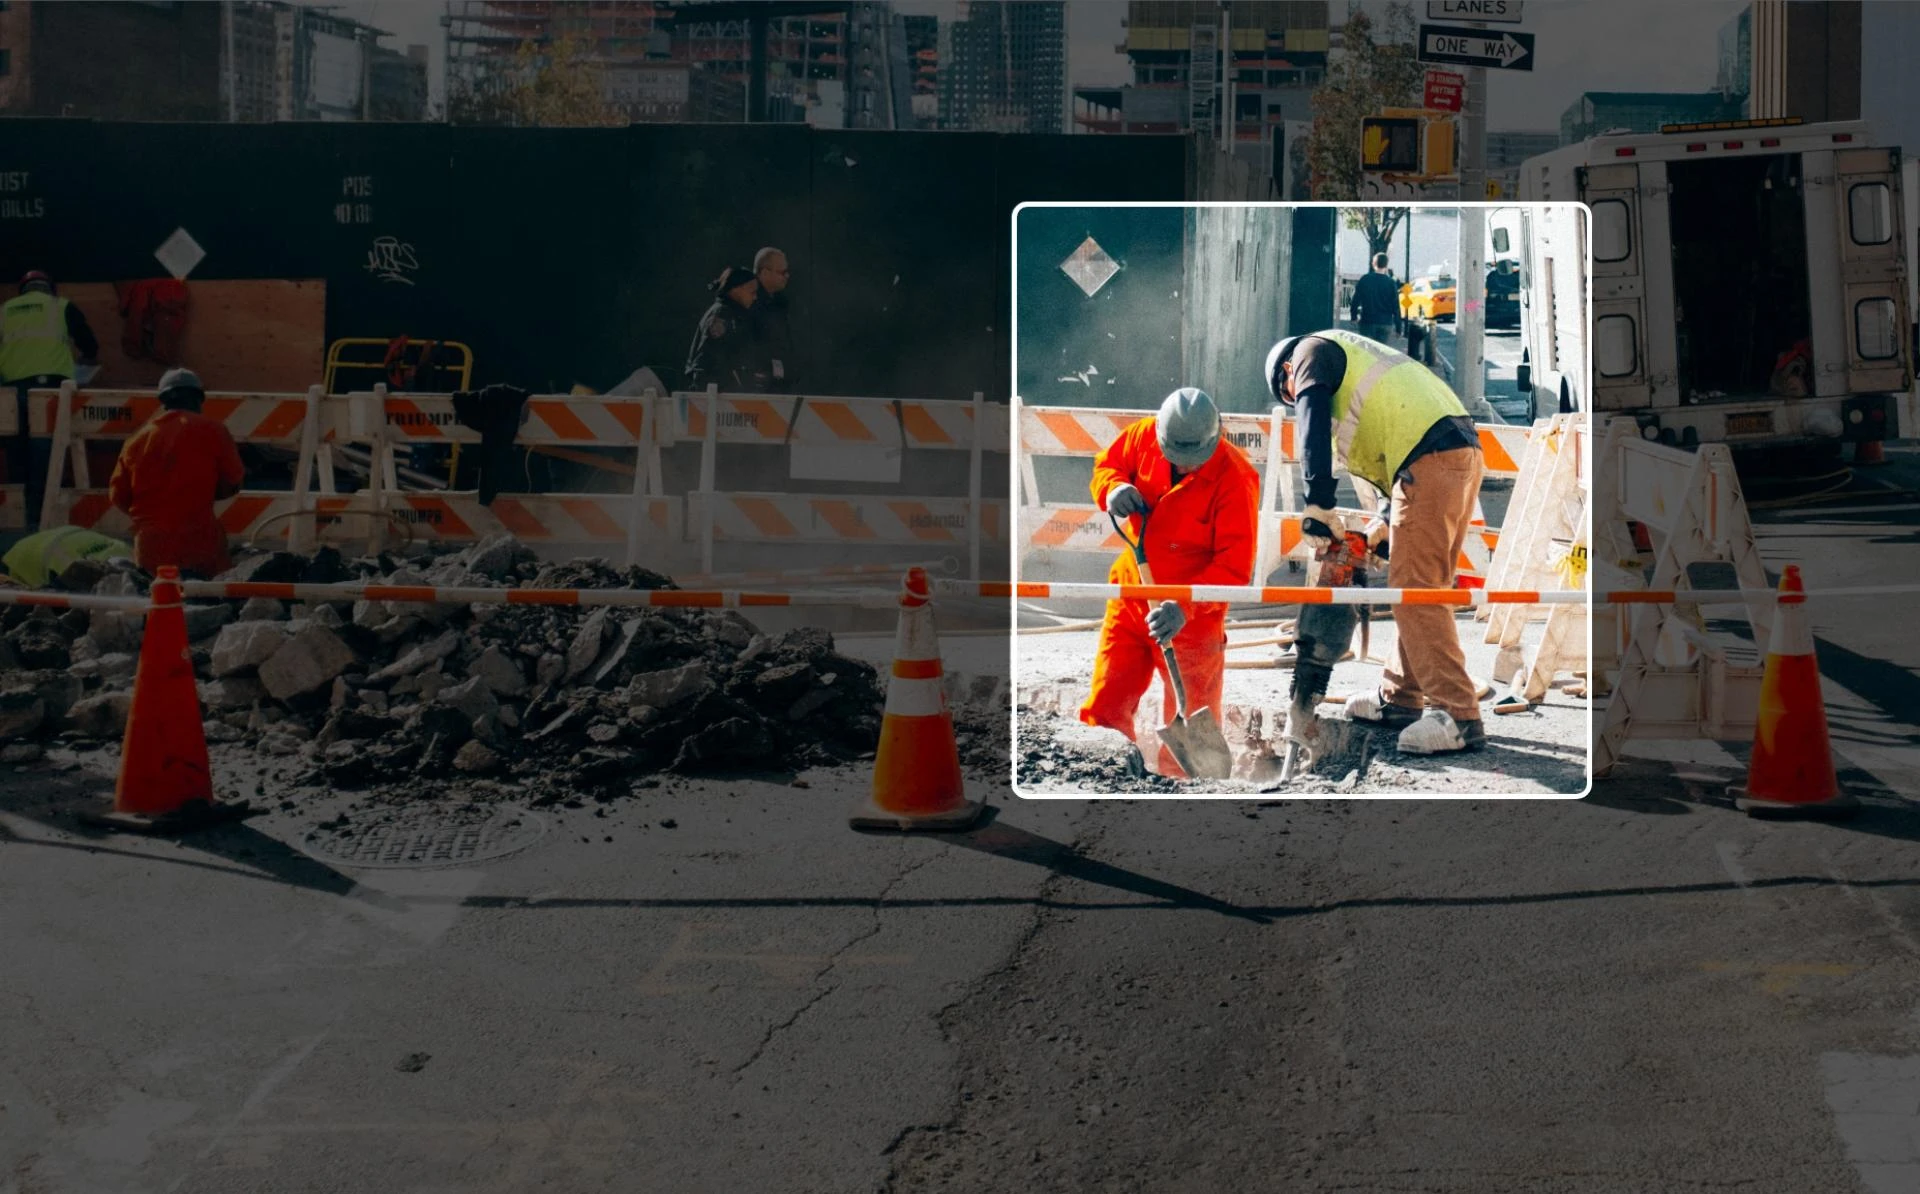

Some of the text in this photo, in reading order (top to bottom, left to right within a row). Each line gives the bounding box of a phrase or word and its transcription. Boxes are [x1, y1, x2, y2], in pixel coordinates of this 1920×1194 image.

[1443, 0, 1507, 14] LANES
[1436, 37, 1517, 58] ONE WAY
[82, 404, 132, 422] TRIUMPH
[385, 411, 464, 426] TRIUMP
